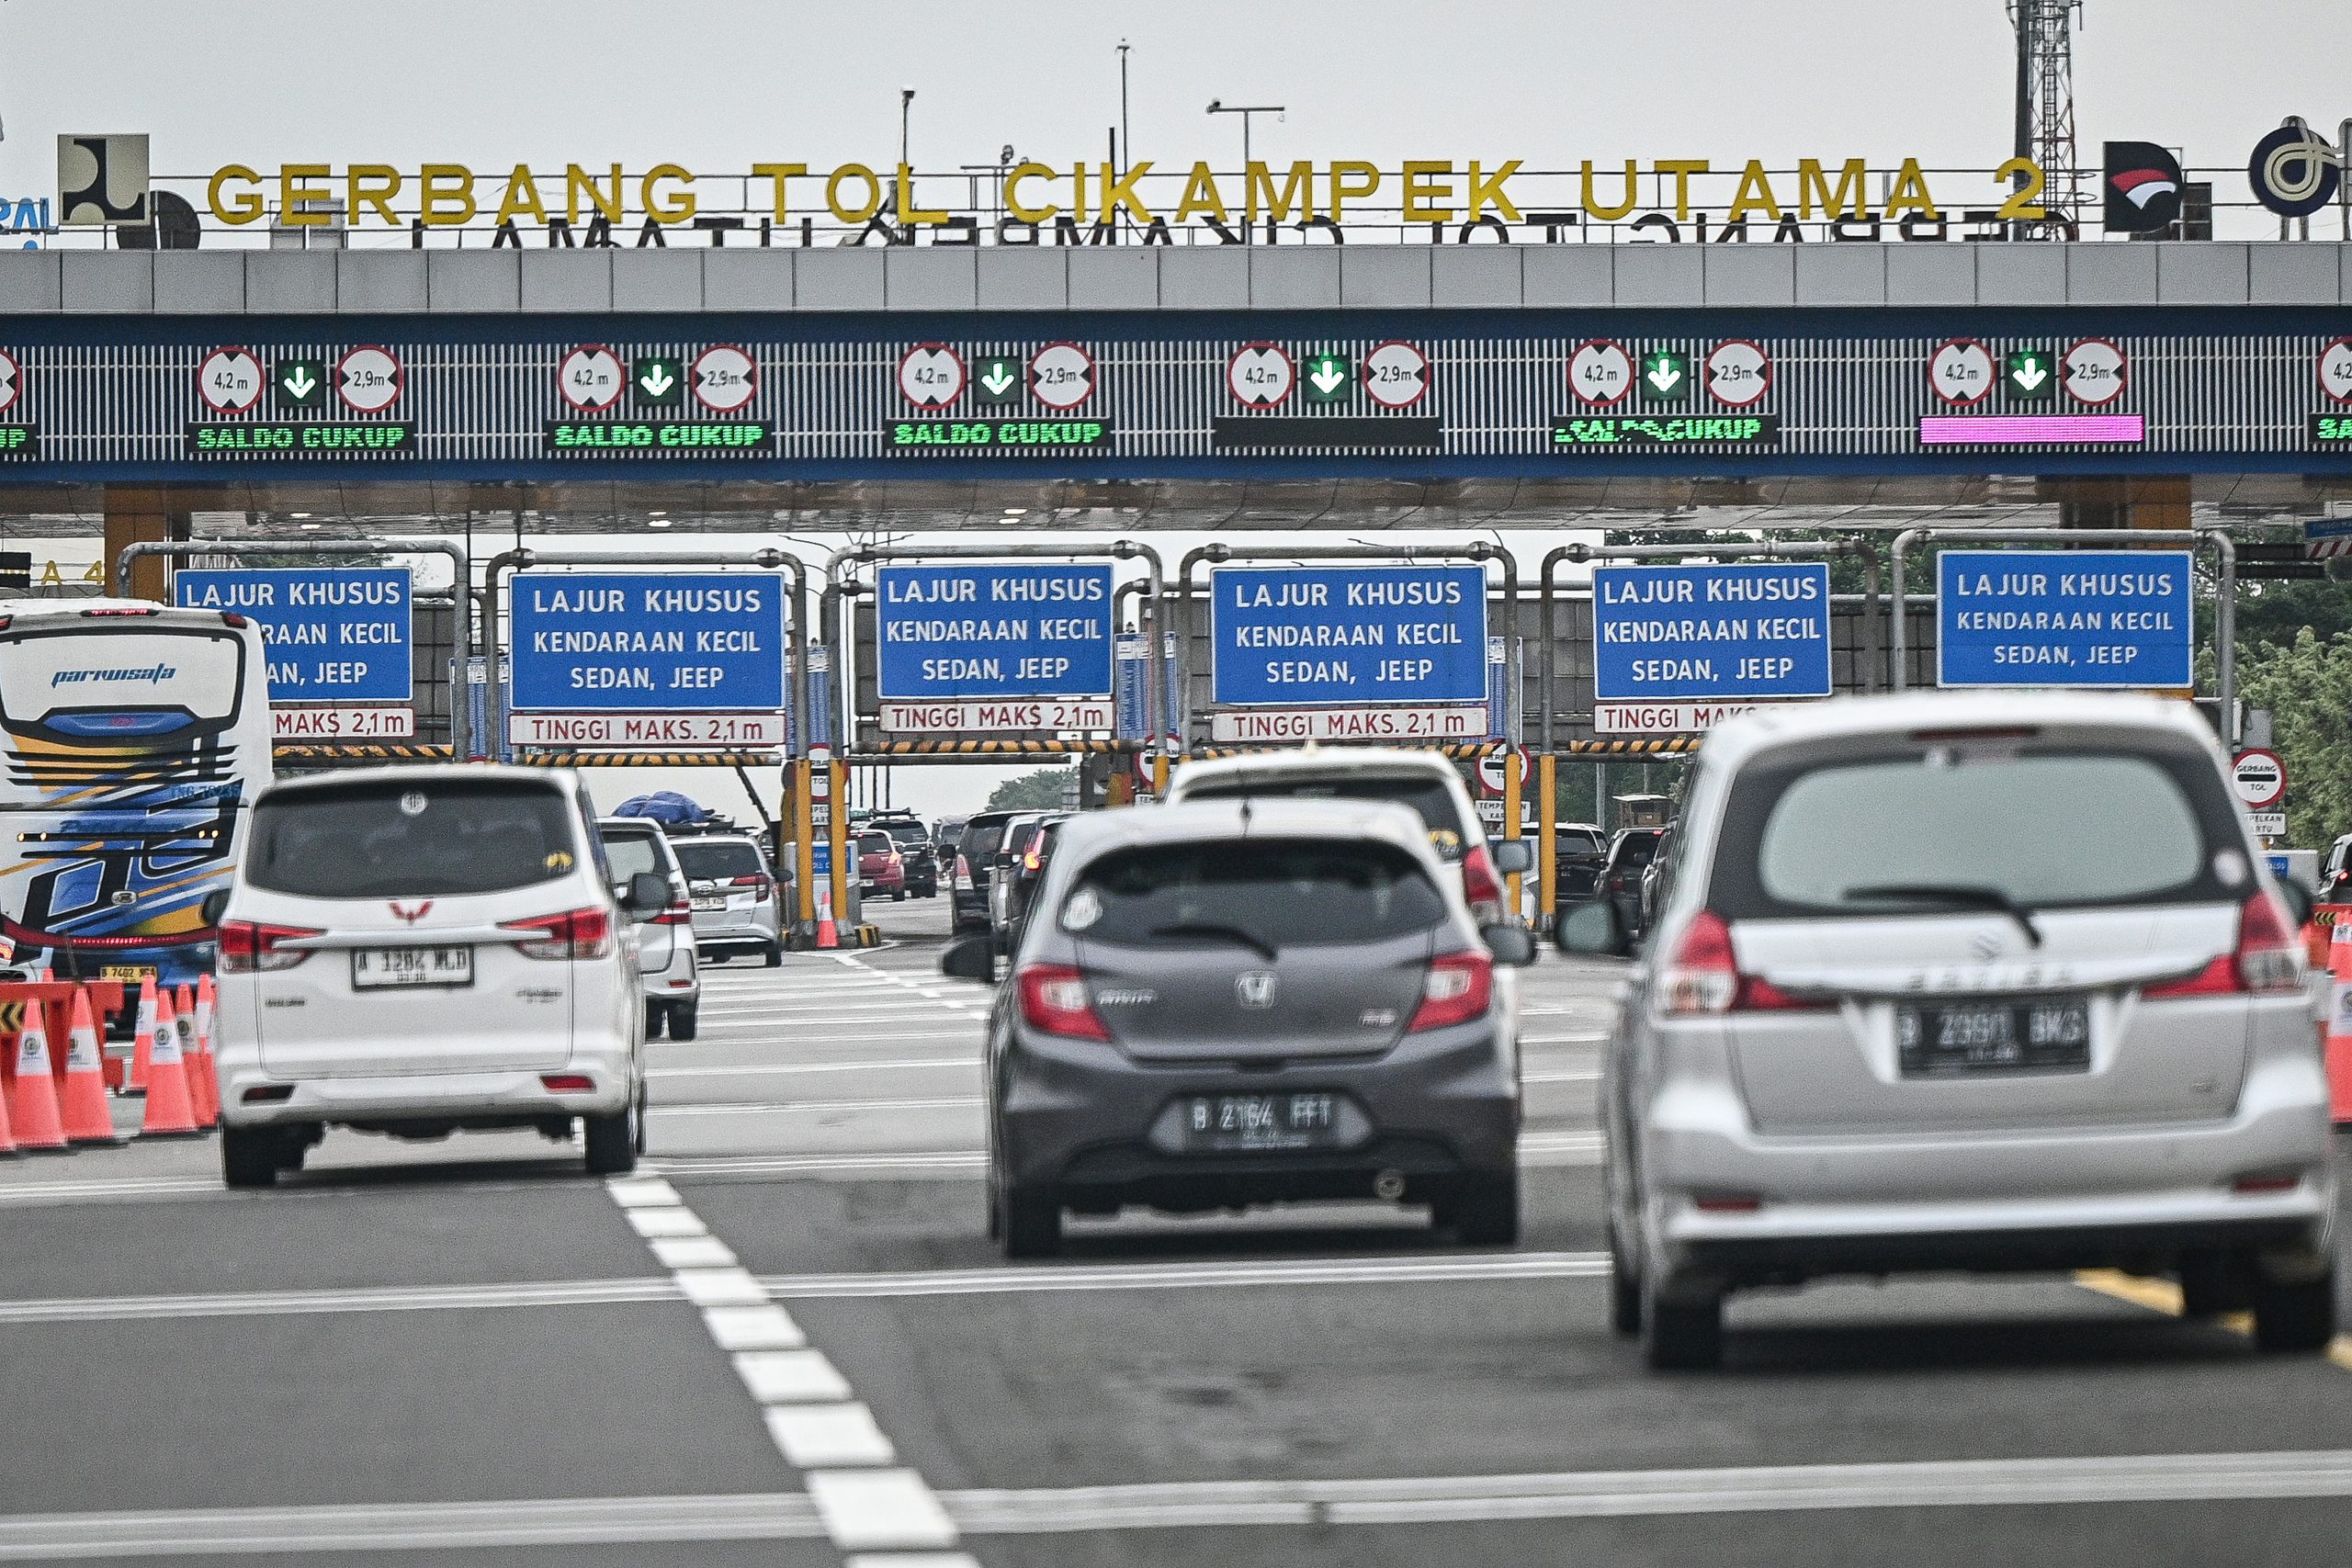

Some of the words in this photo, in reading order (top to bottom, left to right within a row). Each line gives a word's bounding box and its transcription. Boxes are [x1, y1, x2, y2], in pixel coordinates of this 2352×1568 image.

[207, 162, 697, 225] GERBANG
[751, 163, 949, 224] TOL
[1002, 160, 1524, 223] CIKAMPEK
[1580, 157, 1939, 221] UTAMA
[1994, 156, 2047, 220] 2
[213, 371, 234, 391] 4,2
[574, 368, 594, 386] 4,2
[914, 367, 933, 385] 4,2
[1245, 367, 1264, 385] 4,2
[1584, 364, 1604, 382] 4,2
[1945, 364, 1965, 381] 4,2
[197, 427, 294, 449] SALDO
[302, 426, 405, 448] CUKUP
[554, 425, 654, 446] SALDO
[660, 424, 763, 446] CUKUP
[893, 423, 992, 445] SALDO
[998, 423, 1102, 444] CUKUP
[186, 581, 275, 607] LAJUR
[288, 581, 401, 605] KHUSUS
[888, 578, 977, 604] LAJUR
[991, 577, 1103, 603] KHUSUS
[1236, 583, 1329, 608] LAJUR
[1347, 581, 1462, 606] KHUSUS
[1603, 580, 1694, 604] LAJUR
[1706, 576, 1818, 602] KHUSUS
[1958, 573, 2048, 597] LAJUR
[2061, 573, 2173, 597] KHUSUS
[534, 589, 626, 613] LAJUR
[645, 589, 762, 613] KHUSUS
[887, 620, 1028, 642] KENDARAAN
[1039, 618, 1102, 640] KECIL
[1603, 619, 1748, 643] KENDARAAN
[1757, 617, 1821, 640] KECIL
[1957, 611, 2102, 631] KENDARAAN
[2110, 611, 2175, 631] KECIL
[340, 623, 402, 644] KECIL
[534, 631, 684, 652] KENDARAAN
[696, 630, 762, 652] KECIL
[1236, 625, 1384, 648] KENDARAAN
[1396, 623, 1463, 645] KECIL
[1994, 646, 2075, 668] SEDAN,
[2086, 646, 2139, 664] JEEP
[51, 662, 177, 689] pariwisata
[267, 662, 306, 687] AN,
[314, 661, 368, 683] JEEP
[570, 667, 655, 691] SEDAN,
[669, 667, 724, 689] JEEP
[922, 658, 1006, 682] SEDAN,
[1014, 657, 1069, 679] JEEP
[1266, 660, 1357, 685] SEDAN,
[1375, 659, 1434, 682] JEEP
[1631, 659, 1719, 682] SEDAN,
[1736, 658, 1793, 680] JEEP
[276, 713, 341, 734] MAKS
[892, 707, 965, 728] TINGGI
[1233, 715, 1314, 738] TINGGI
[1604, 707, 1679, 729] TINGGI
[532, 719, 611, 740] TINGGI
[2250, 783, 2267, 791] TOL
